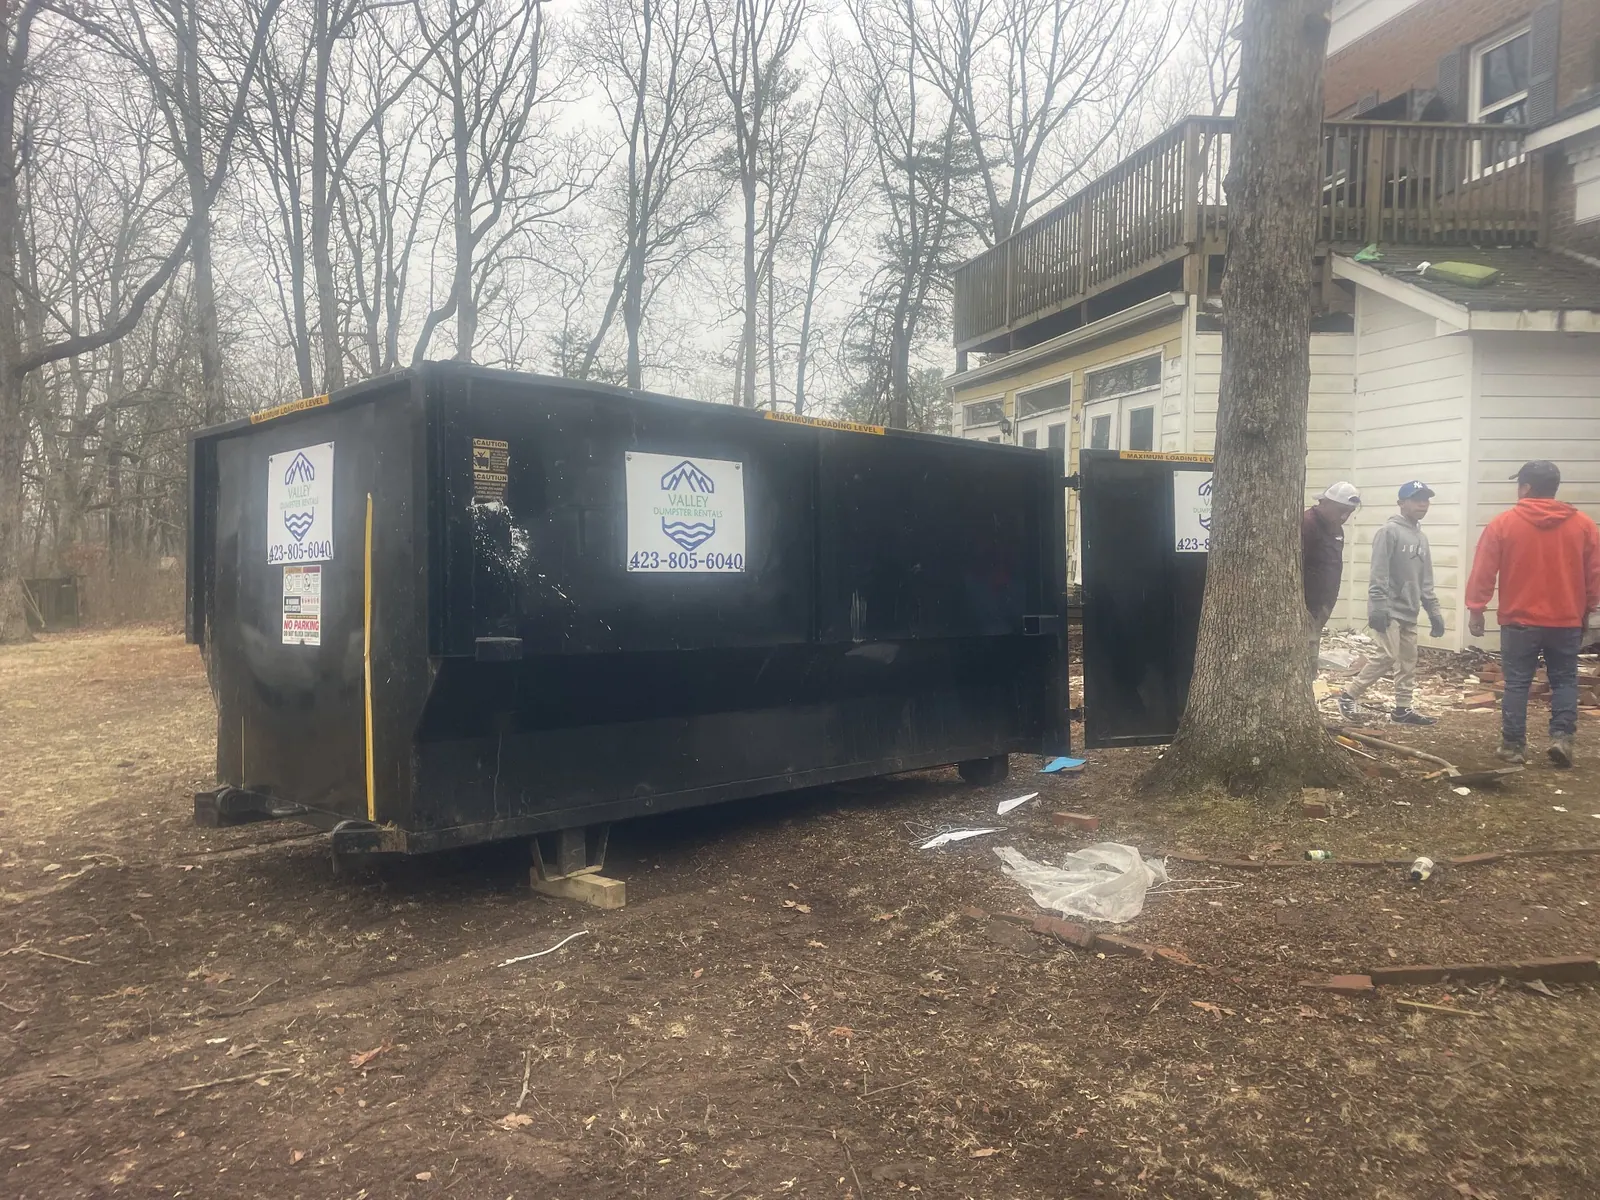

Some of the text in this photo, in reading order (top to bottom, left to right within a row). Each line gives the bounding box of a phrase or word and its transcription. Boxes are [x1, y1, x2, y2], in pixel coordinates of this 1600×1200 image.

[281, 402, 304, 414] LOADING
[306, 398, 324, 407] LEVEL
[772, 413, 877, 433] MAXIMUM LOADING LEVEL
[477, 440, 507, 448] CAUTION
[287, 484, 311, 499] VALLEY
[668, 493, 709, 508] VALLEY
[653, 507, 723, 518] DUMPSTER RENTALS
[269, 540, 332, 561] 423-805-6040
[1177, 538, 1210, 550] 423-8
[630, 551, 743, 569] 423-805-6040
[284, 620, 319, 631] NO PARKING
